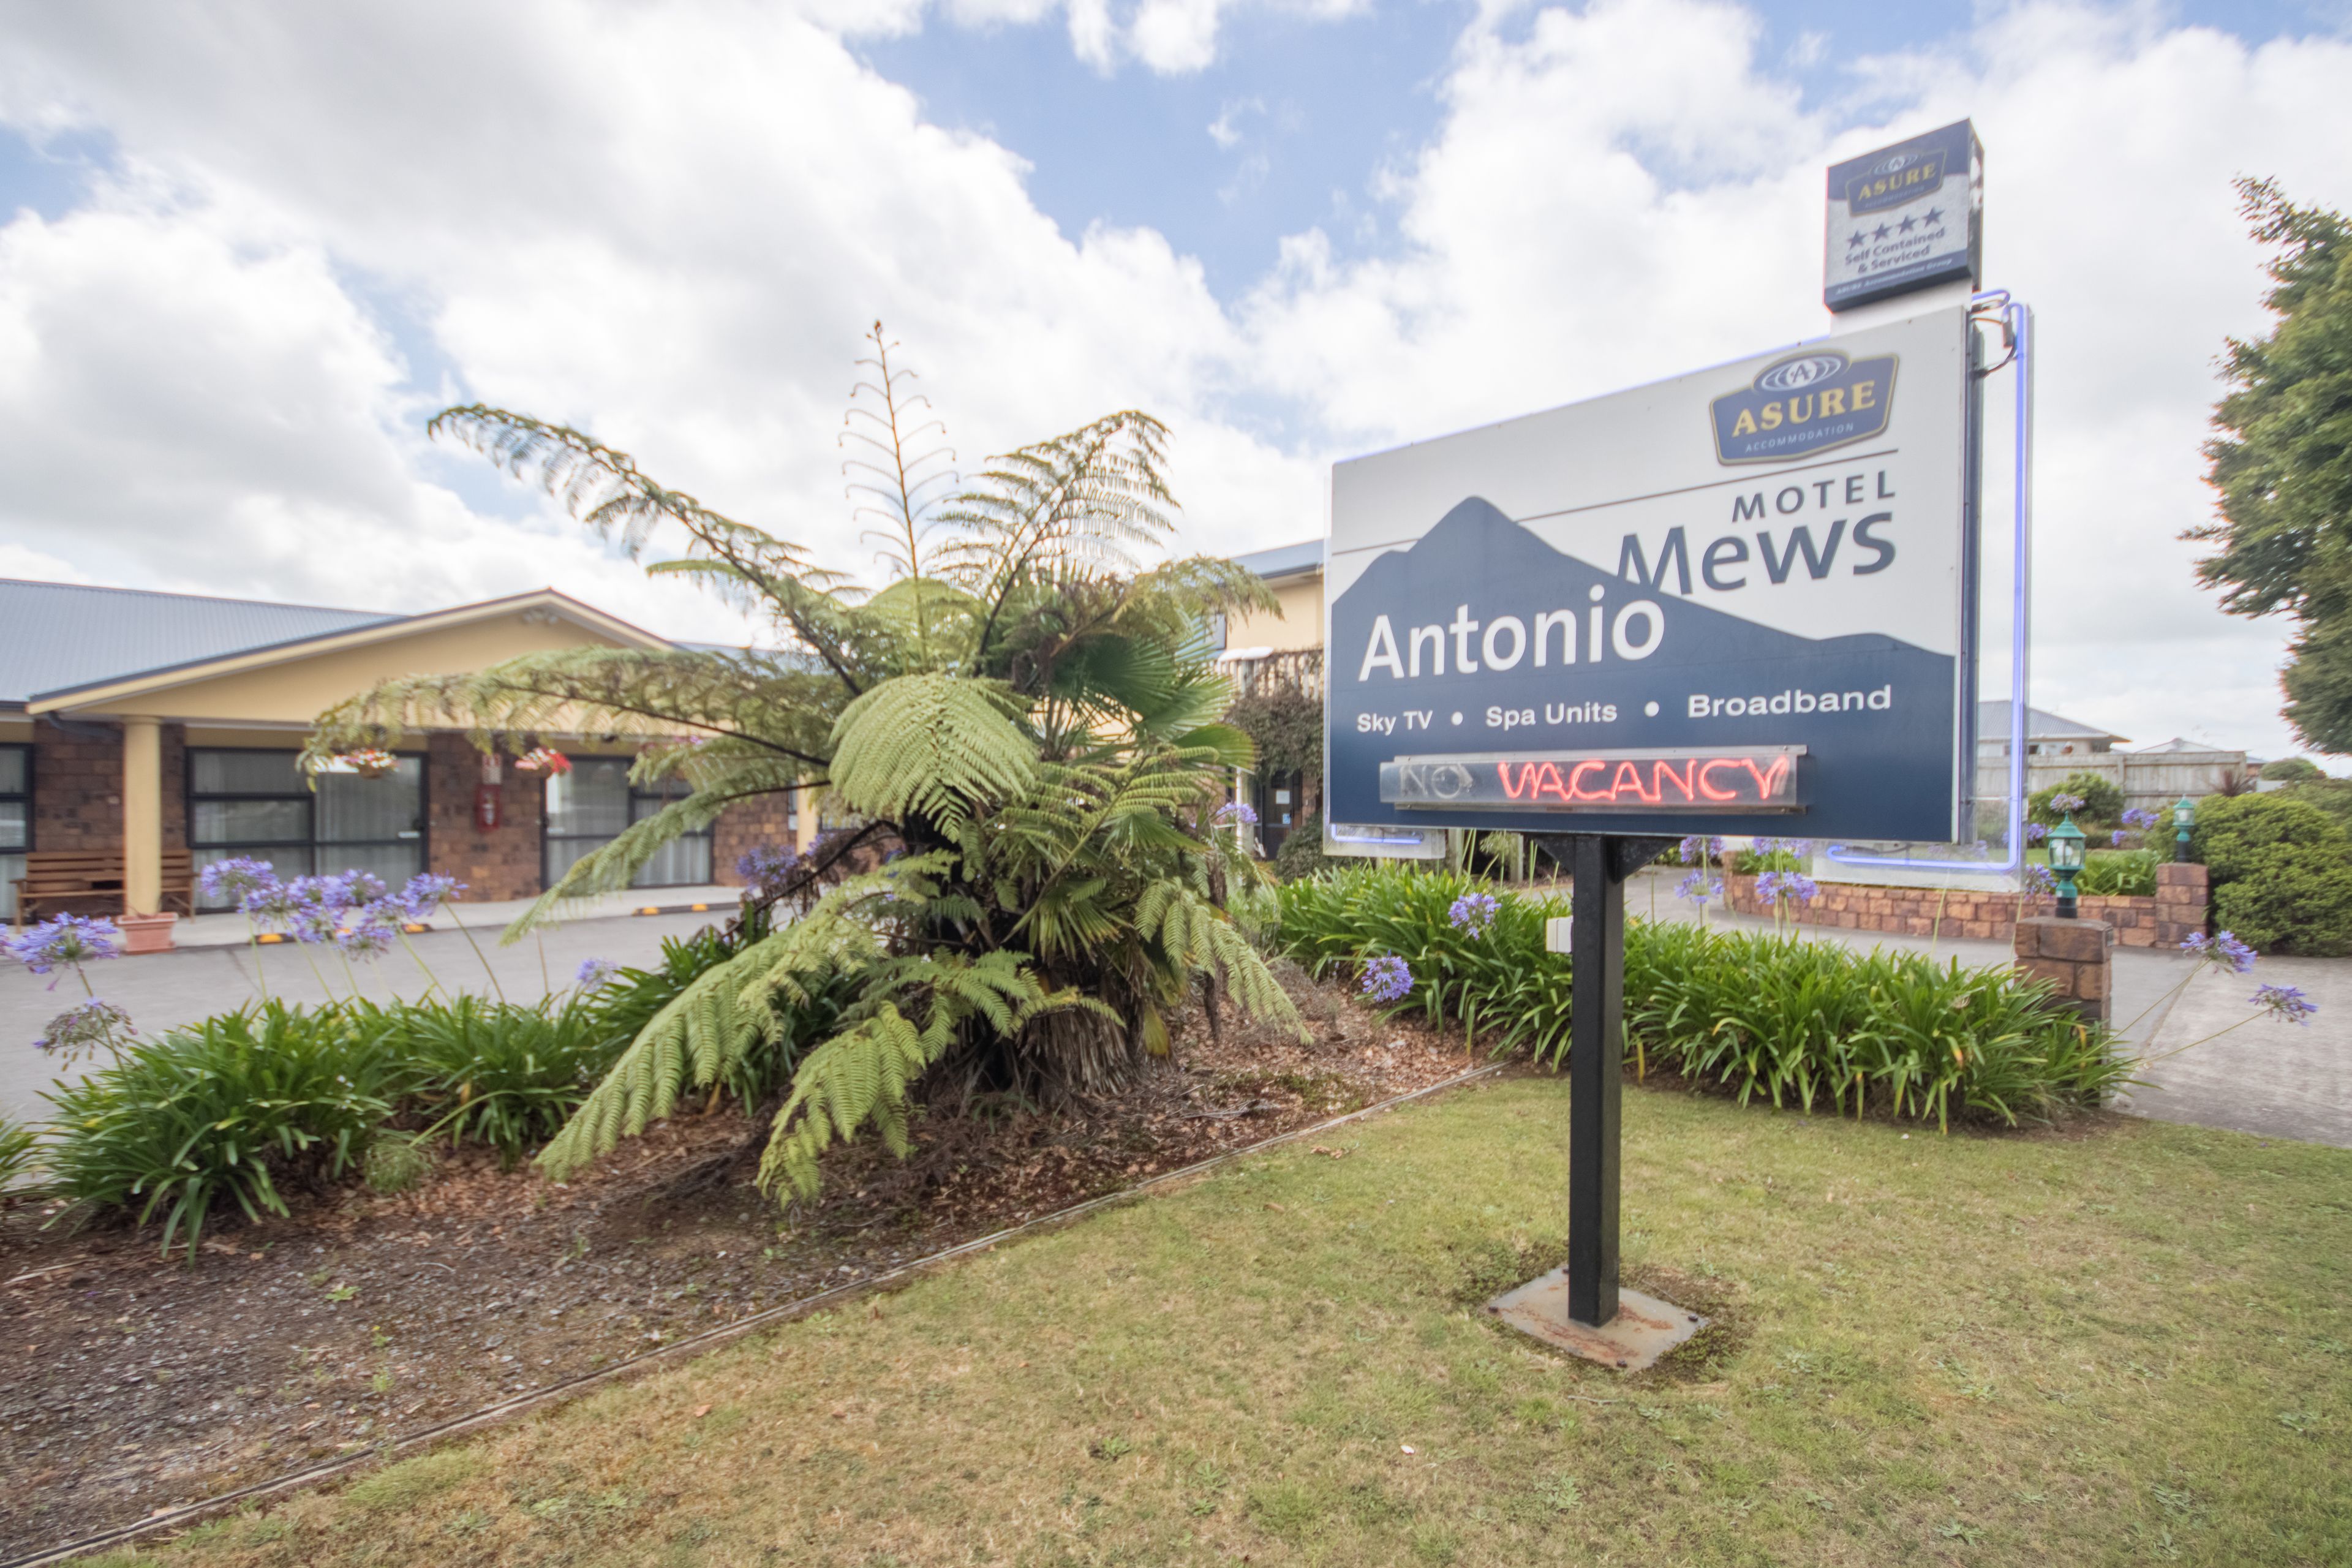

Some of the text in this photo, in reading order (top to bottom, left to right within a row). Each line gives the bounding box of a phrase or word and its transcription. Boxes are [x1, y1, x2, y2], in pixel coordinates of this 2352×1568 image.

[1858, 162, 1936, 201] ASURE
[1845, 226, 1945, 266] Self Contained
[1858, 244, 1930, 274] & Serviced
[1731, 380, 1877, 437] ASURE
[1745, 422, 1855, 453] ACCOMMODATION
[1732, 470, 1896, 523] MOTEL
[1616, 511, 1897, 596] Mews
[1358, 584, 1665, 682] Antonio
[1356, 684, 1891, 736] Sky TV Spa Units Broadband
[1399, 755, 1790, 802] NO VACANCY
